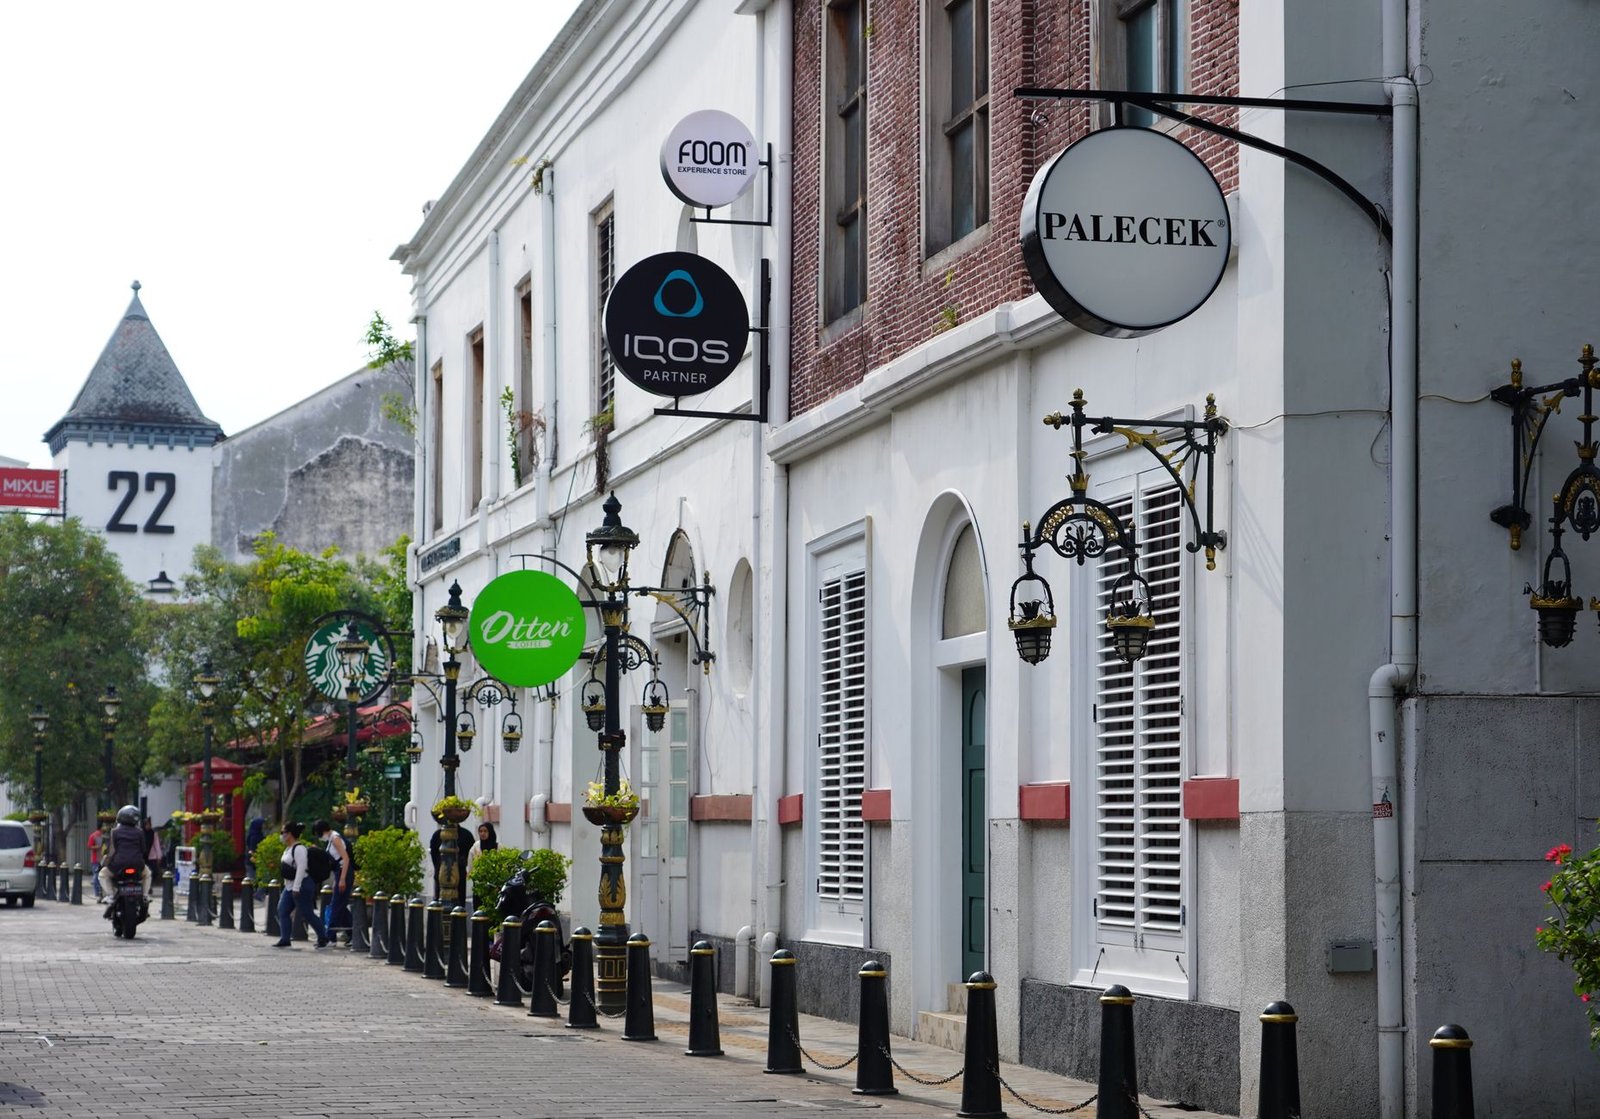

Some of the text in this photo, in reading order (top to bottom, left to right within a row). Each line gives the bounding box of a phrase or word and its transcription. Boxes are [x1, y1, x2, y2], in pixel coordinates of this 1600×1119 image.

[678, 140, 747, 167] FOOM
[677, 166, 747, 176] EXPERIENCE STORE
[624, 333, 730, 365] IQOS
[643, 369, 707, 384] PARTNER
[3, 477, 56, 494] MIXUE
[106, 470, 176, 534] 22
[480, 610, 572, 644] Otten
